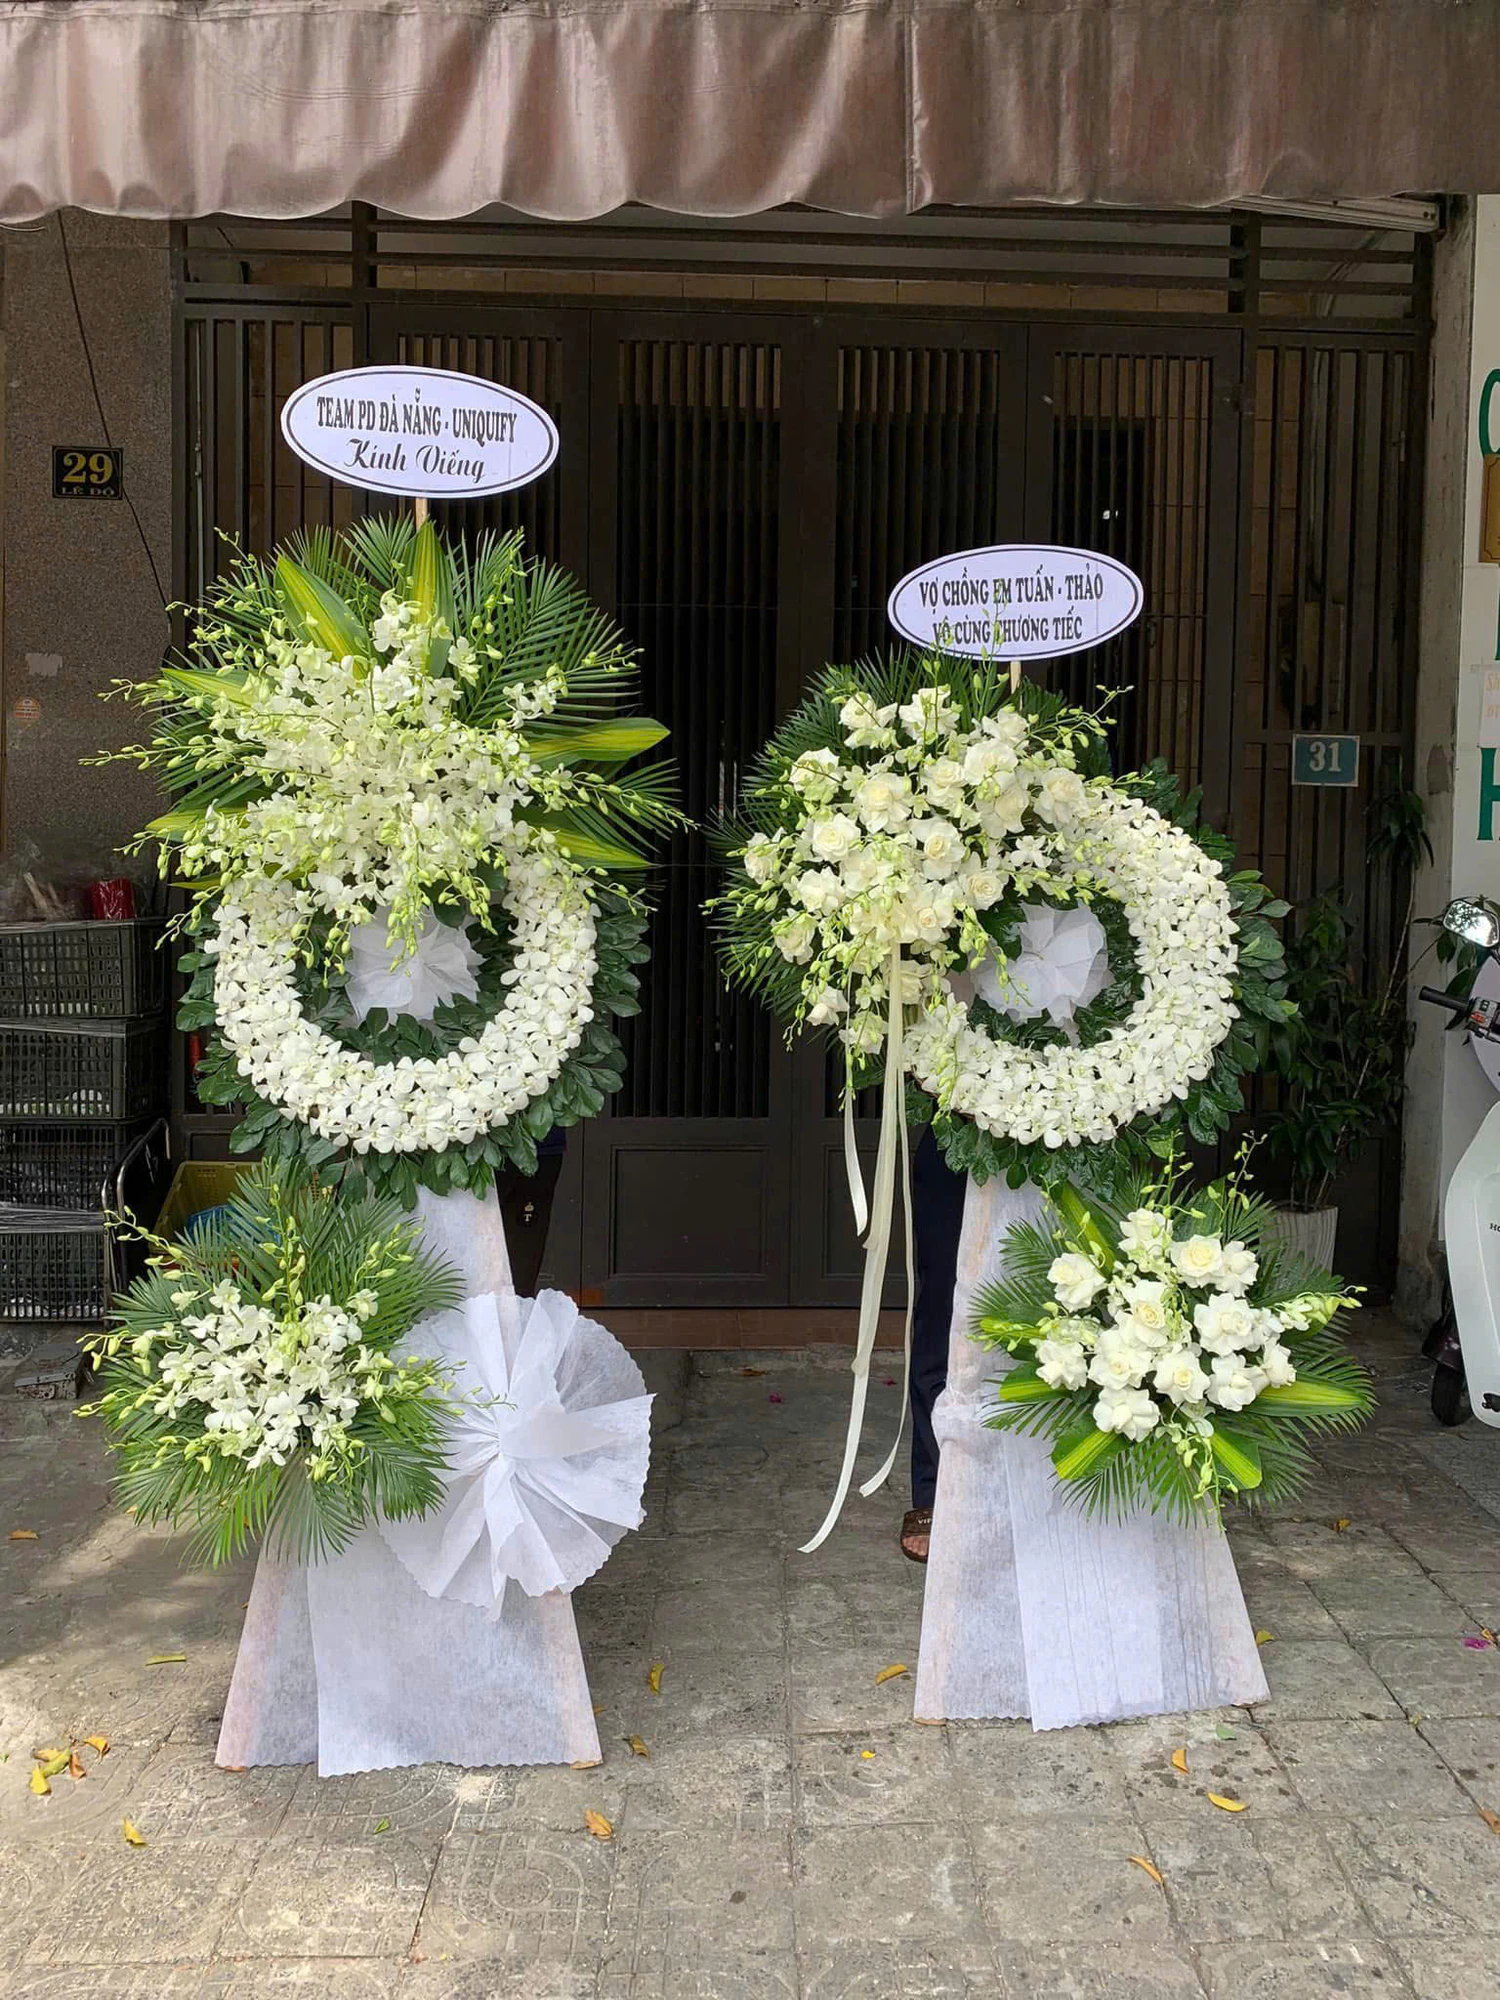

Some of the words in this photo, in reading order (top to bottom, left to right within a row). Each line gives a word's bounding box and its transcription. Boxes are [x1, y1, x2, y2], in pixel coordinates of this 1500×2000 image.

[316, 396, 354, 430] TEAM
[358, 400, 376, 431] PD
[379, 393, 399, 433] ĐÀ
[452, 408, 517, 448] UNIQUIFY
[62, 452, 113, 484] 29
[344, 438, 407, 471] Kính
[416, 444, 485, 484] Viếng
[919, 576, 938, 615] VỢ
[942, 566, 989, 605] CHỒNG
[993, 577, 1012, 604] EM
[1015, 564, 1055, 603] TUẤN
[1065, 563, 1103, 601] THẢO
[954, 614, 990, 645] CÙNG
[1053, 606, 1082, 641] TIẾC
[1308, 741, 1342, 772] 31
